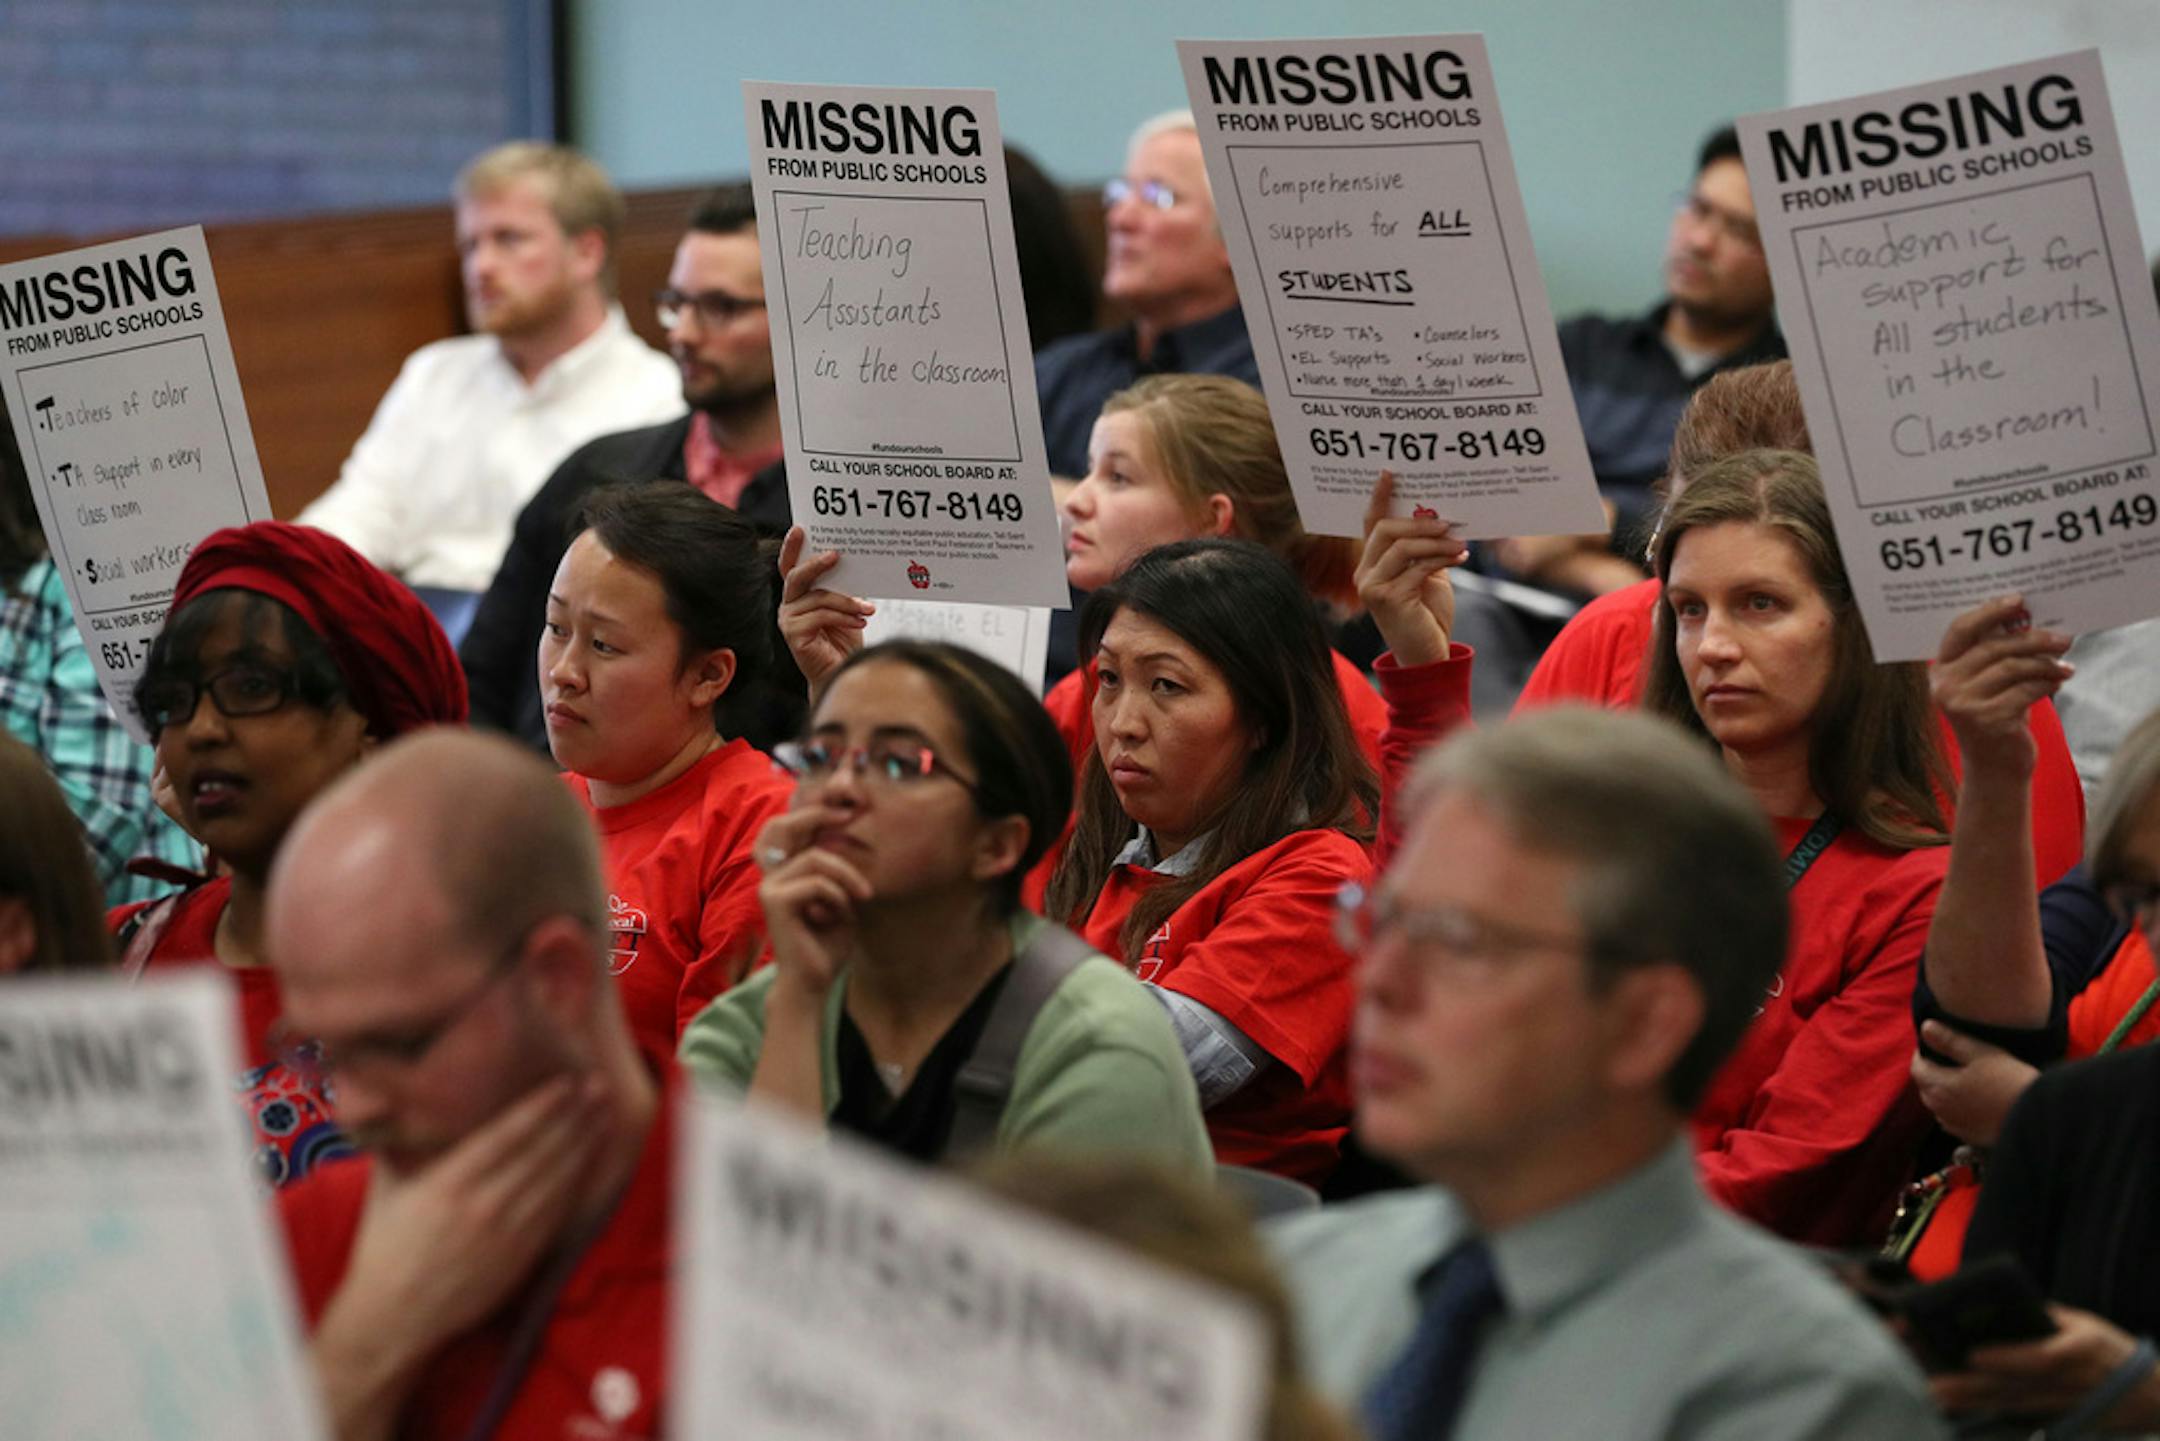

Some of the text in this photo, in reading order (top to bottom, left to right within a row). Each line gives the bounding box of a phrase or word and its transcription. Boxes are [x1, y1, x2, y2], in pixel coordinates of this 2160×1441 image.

[1202, 51, 1472, 105] MISSING
[761, 99, 981, 157] MISSING
[1217, 108, 1481, 132] FROM PUBLIC SCHOOLS
[1767, 74, 2084, 184] MISSING
[768, 157, 988, 185] FROM PUBLIC SCHOOLS
[1259, 166, 1404, 203] Comprehensive
[1782, 135, 2094, 213] FROM PUBLIC SCHOOLS
[790, 206, 912, 278] Teaching
[1268, 208, 1471, 249] supports for ALL
[1815, 209, 2010, 276] Academic
[0, 247, 196, 330] MISSING
[1278, 269, 1414, 294] STUDENTS
[1860, 235, 2099, 310] support for
[803, 277, 942, 331] Assistants
[1873, 284, 2108, 356] All students
[8, 301, 204, 355] FROM PUBLIC SCHOOLS
[1292, 324, 1383, 342] SPED TA's
[1423, 324, 1500, 344] Counselors
[814, 346, 1007, 385] in the classroom
[1299, 351, 1321, 364] EL
[1424, 352, 1464, 369] Social
[1884, 355, 2006, 399] in the
[122, 391, 139, 417] of
[152, 381, 189, 410] color
[1301, 402, 1538, 420] CALL YOUR SCHOOL BOARD AT:
[1890, 375, 2106, 457] Classroom!
[1310, 427, 1546, 461] 651-767-8149
[57, 462, 87, 488] TA
[150, 457, 163, 473] in
[168, 447, 202, 473] every
[809, 459, 1018, 481] CALL YOUR SCHOOL BOARD AT:
[813, 485, 1023, 522] 651-767-8149
[1870, 511, 1913, 527] CALL
[1917, 503, 1967, 521] YOUR
[1970, 491, 2048, 515] SCHOOL
[2053, 471, 2120, 498] BOARD
[1879, 494, 2158, 571] 651-767-8149
[91, 608, 168, 631] CALL YOUR SCH
[101, 638, 152, 669] 651-7
